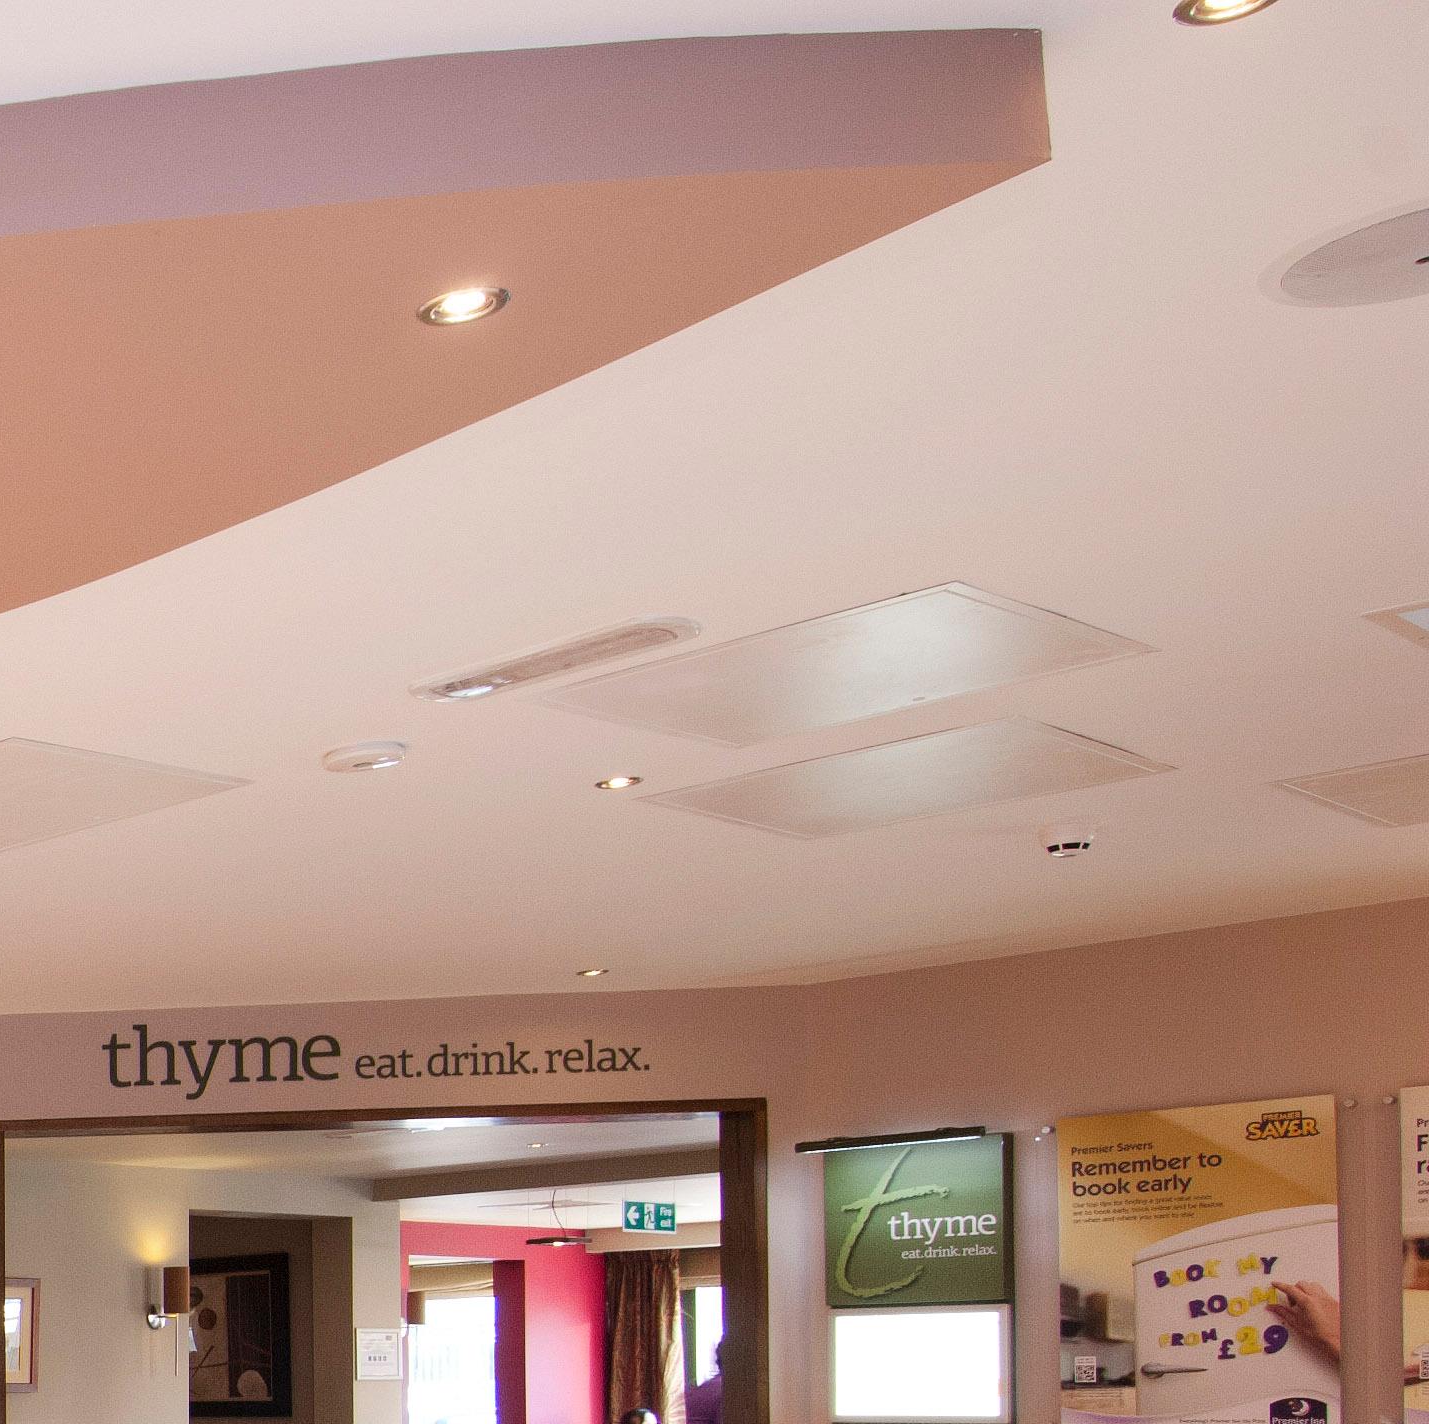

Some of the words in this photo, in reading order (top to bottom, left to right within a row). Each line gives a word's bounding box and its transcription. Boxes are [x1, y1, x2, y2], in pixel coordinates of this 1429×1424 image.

[102, 1024, 341, 1100] thyme
[1246, 1118, 1319, 1140] SAVER
[1071, 1145, 1114, 1156] Premier
[1116, 1141, 1153, 1152] Savers
[1071, 1155, 1191, 1177] Remember
[1197, 1152, 1222, 1168] to
[1072, 1178, 1131, 1197] book
[1136, 1174, 1192, 1194] early
[887, 1211, 998, 1245] thyme
[1153, 1257, 1222, 1288] BOOK
[1236, 1252, 1278, 1276] MY
[1188, 1286, 1279, 1318] ROOM
[1158, 1328, 1218, 1349] FROM
[1217, 1324, 1289, 1360] £29
[1272, 1417, 1309, 1424] Premier
[1310, 1417, 1325, 1424] Inn
